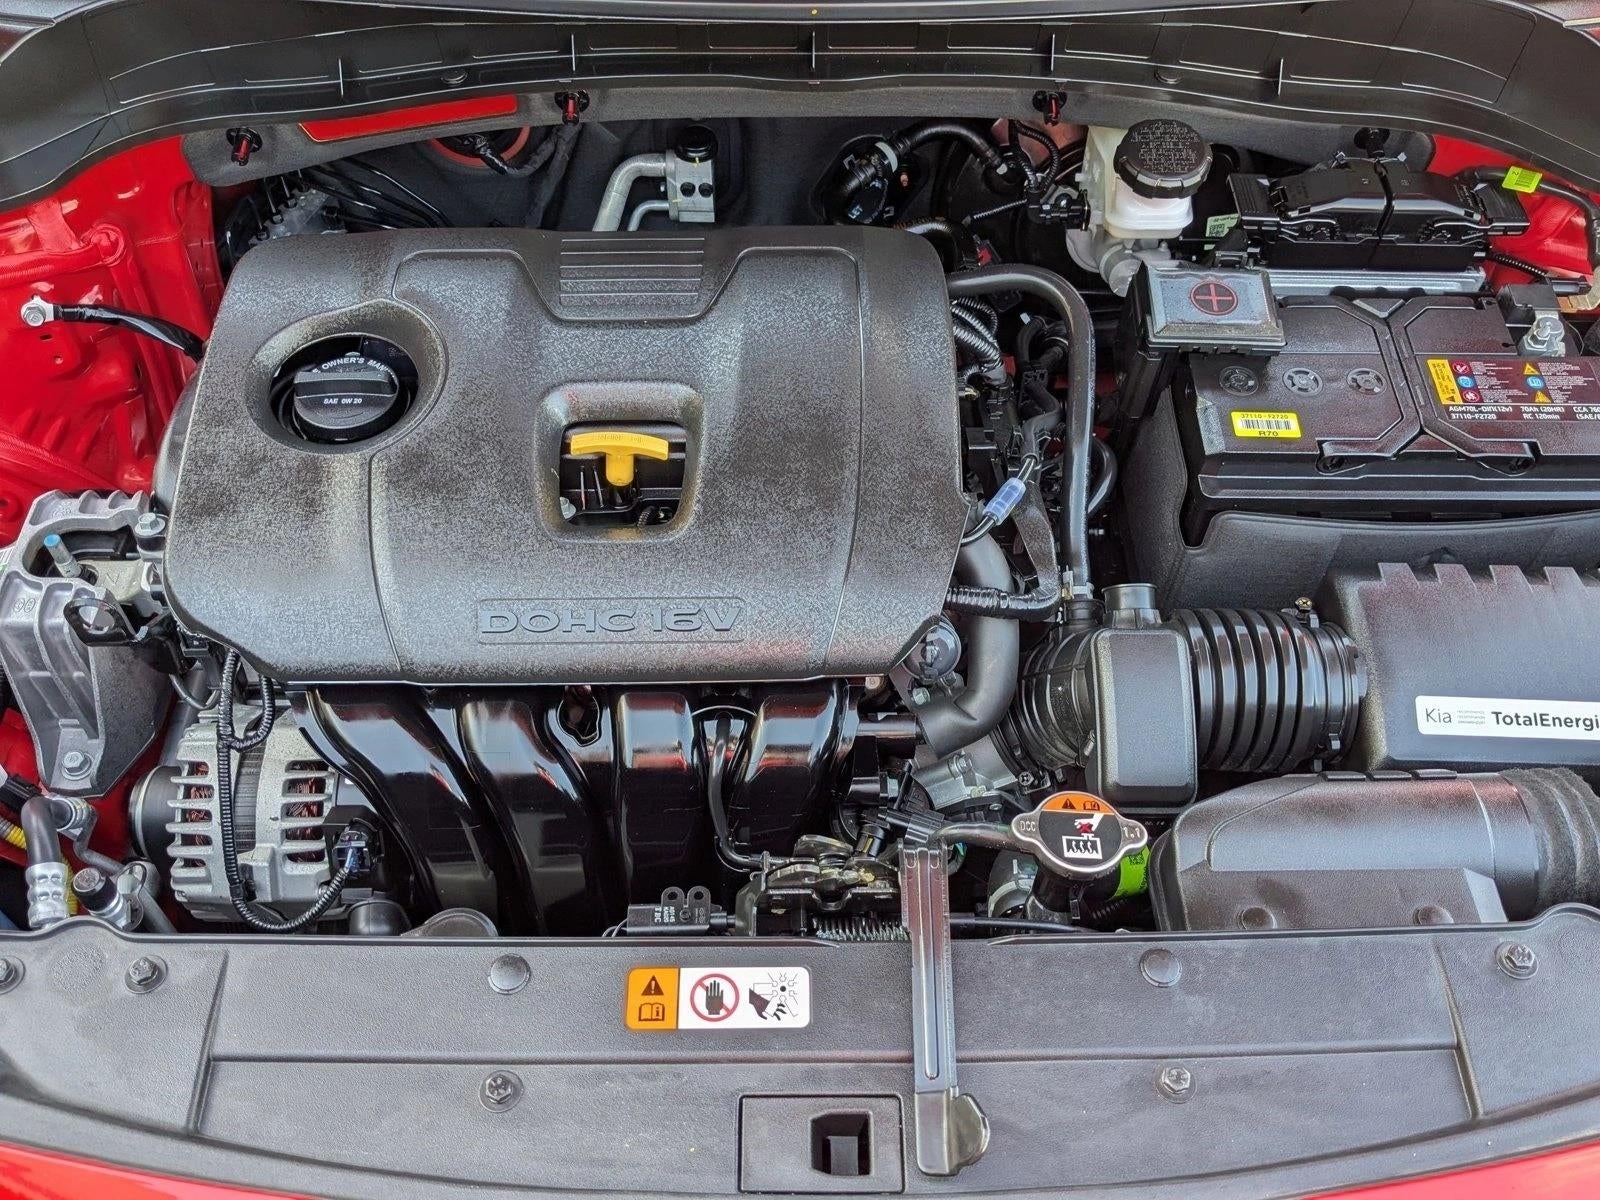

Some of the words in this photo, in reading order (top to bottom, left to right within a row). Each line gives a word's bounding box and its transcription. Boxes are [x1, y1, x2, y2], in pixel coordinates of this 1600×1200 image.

[322, 357, 365, 370] OWNER'S
[481, 608, 636, 634] DOHC
[650, 606, 742, 632] 16V
[1425, 707, 1452, 724] Kia
[1020, 821, 1036, 832] DCC
